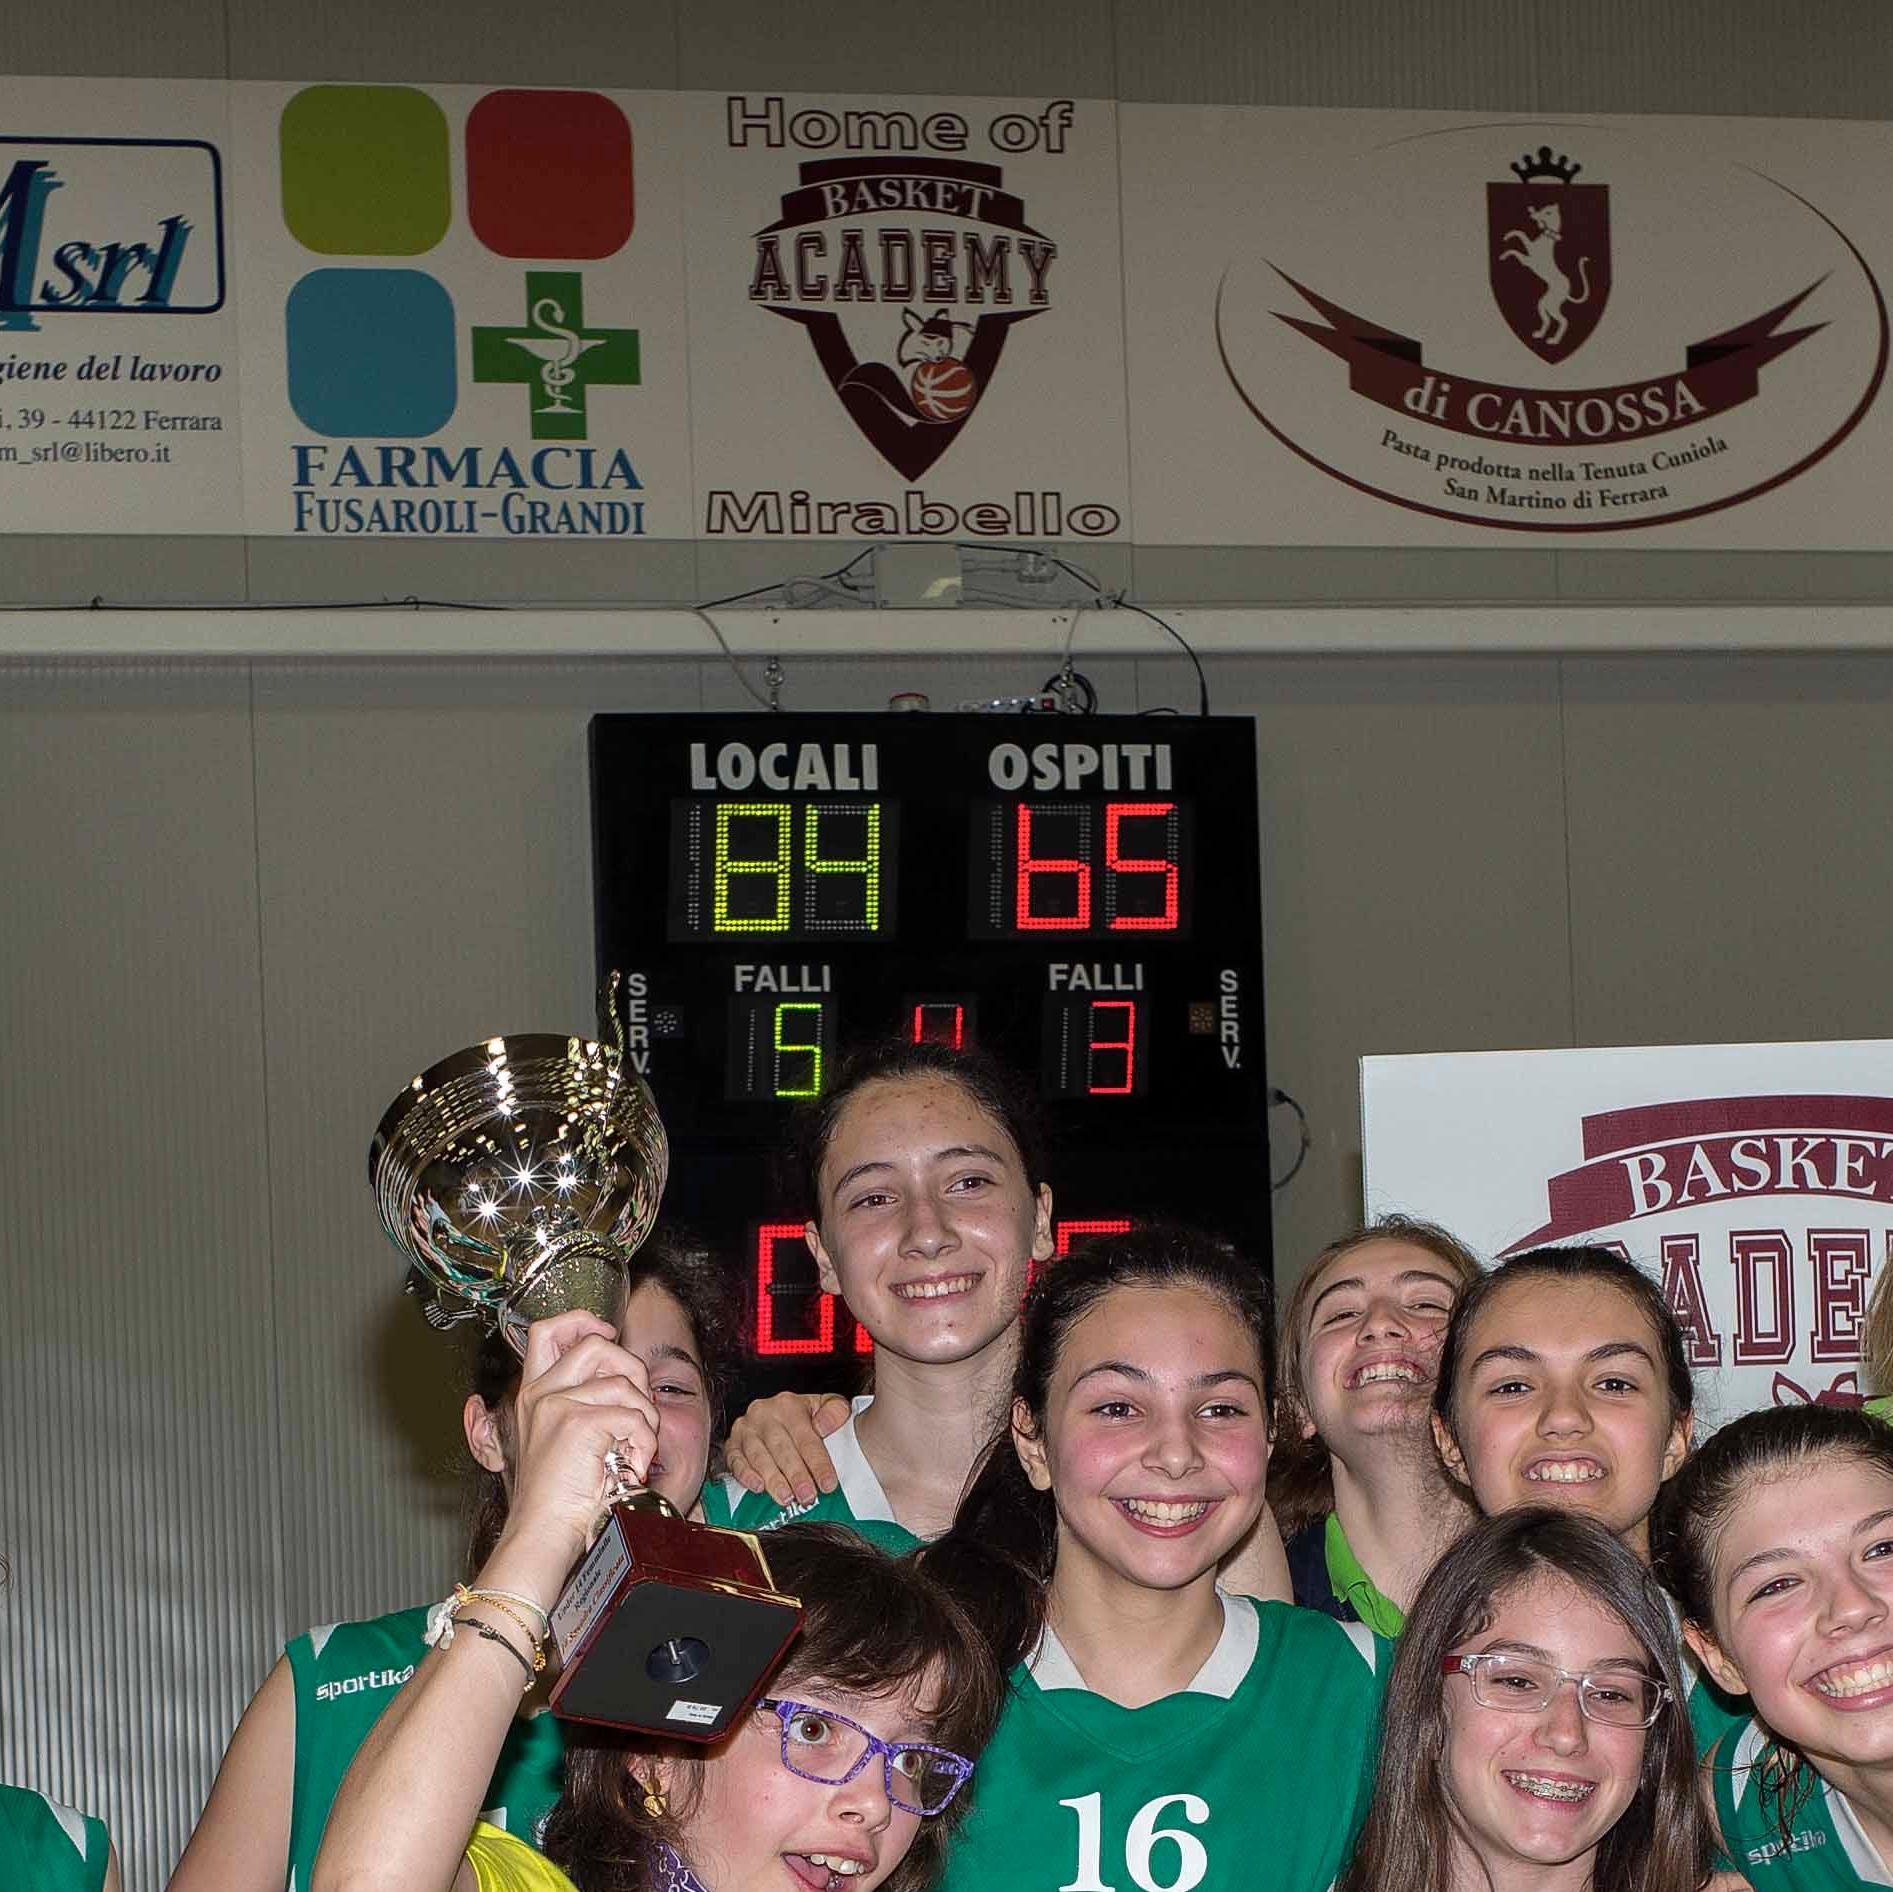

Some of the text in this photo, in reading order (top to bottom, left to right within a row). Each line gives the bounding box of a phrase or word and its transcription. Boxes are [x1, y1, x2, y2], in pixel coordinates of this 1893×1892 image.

[727, 98, 1074, 153] Home of
[823, 179, 994, 219] BASKET
[749, 229, 1058, 305] ACADEMY
[78, 356, 123, 384] del
[131, 357, 222, 385] lavoro
[19, 408, 47, 432] 39
[68, 409, 137, 433] 44122
[144, 410, 222, 434] Ferrara
[1403, 377, 1706, 440] di CANOSSA
[292, 446, 645, 491] FARMACIA
[1380, 429, 1728, 482] Pasta prodotta nella Tenuta Cuniola
[707, 491, 1120, 535] Mirabello
[1443, 478, 1669, 510] San Martino di Ferrara
[690, 743, 1173, 791] LOCALI OSPITI
[714, 803, 1178, 932] 84 65
[734, 964, 1144, 993] FALLI FALLI
[774, 1003, 822, 1097] 5
[1089, 1001, 1135, 1094] 3
